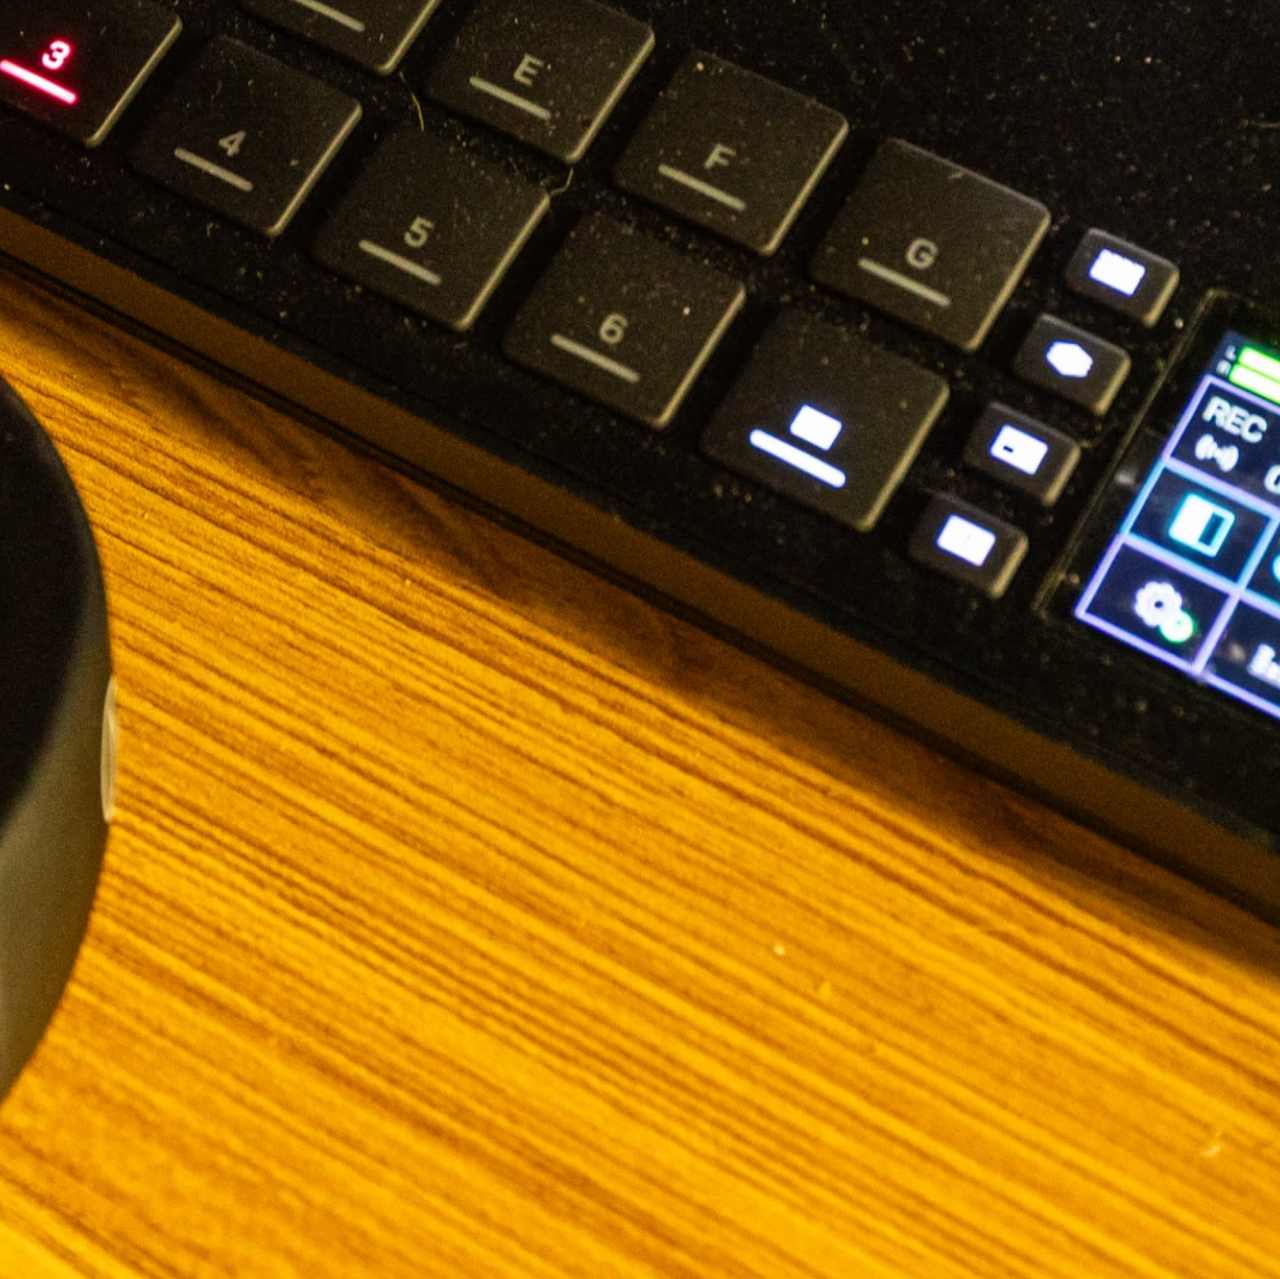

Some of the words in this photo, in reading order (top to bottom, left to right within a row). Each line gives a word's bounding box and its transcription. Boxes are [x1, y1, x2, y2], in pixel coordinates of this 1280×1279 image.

[40, 38, 73, 72] 3
[513, 53, 544, 86] E
[218, 131, 245, 157] 4
[705, 142, 731, 171] F
[404, 216, 434, 248] 5
[904, 237, 939, 271] G
[598, 311, 629, 346] 6
[1202, 396, 1268, 443] REC
